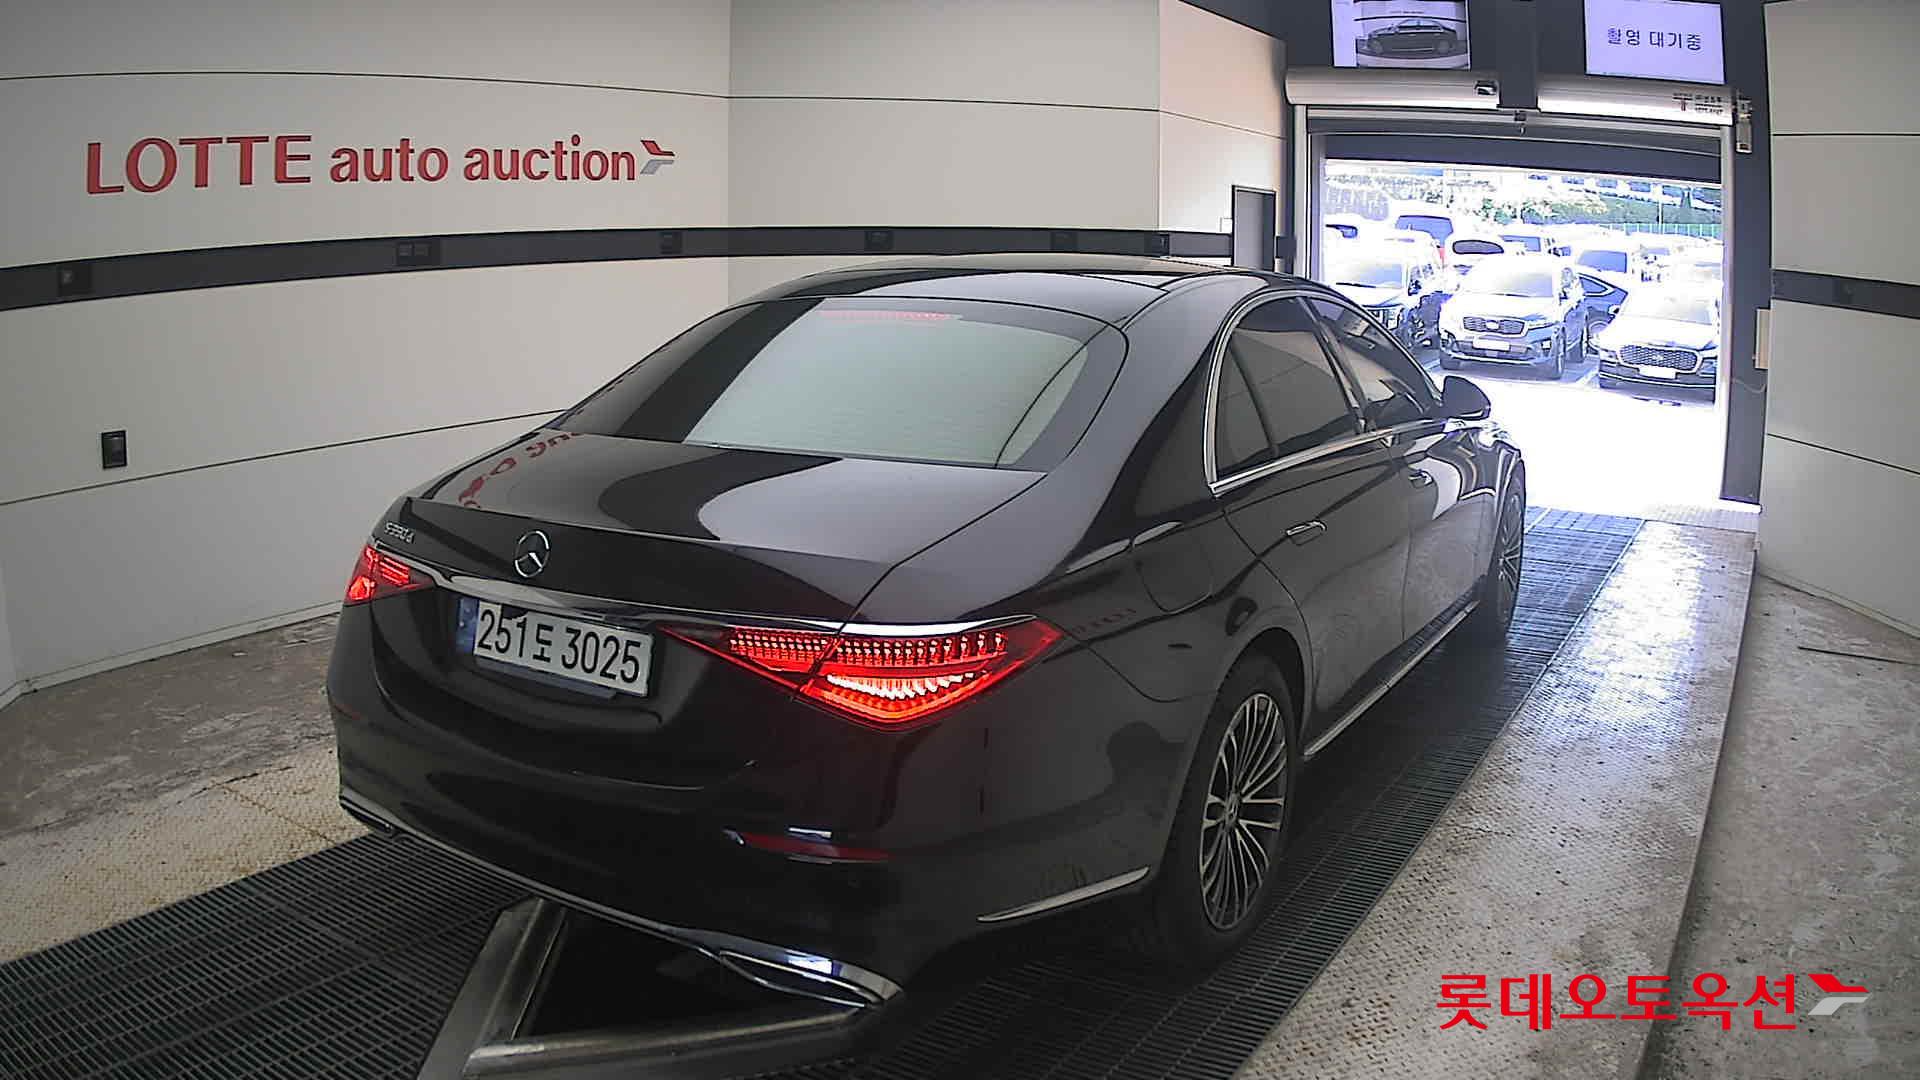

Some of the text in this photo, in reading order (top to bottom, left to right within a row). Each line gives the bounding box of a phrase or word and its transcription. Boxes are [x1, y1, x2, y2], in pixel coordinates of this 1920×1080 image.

[1649, 31, 1702, 51] 대기중
[87, 134, 637, 194] LOTTE auto auction
[477, 609, 642, 684] 251도 3025
